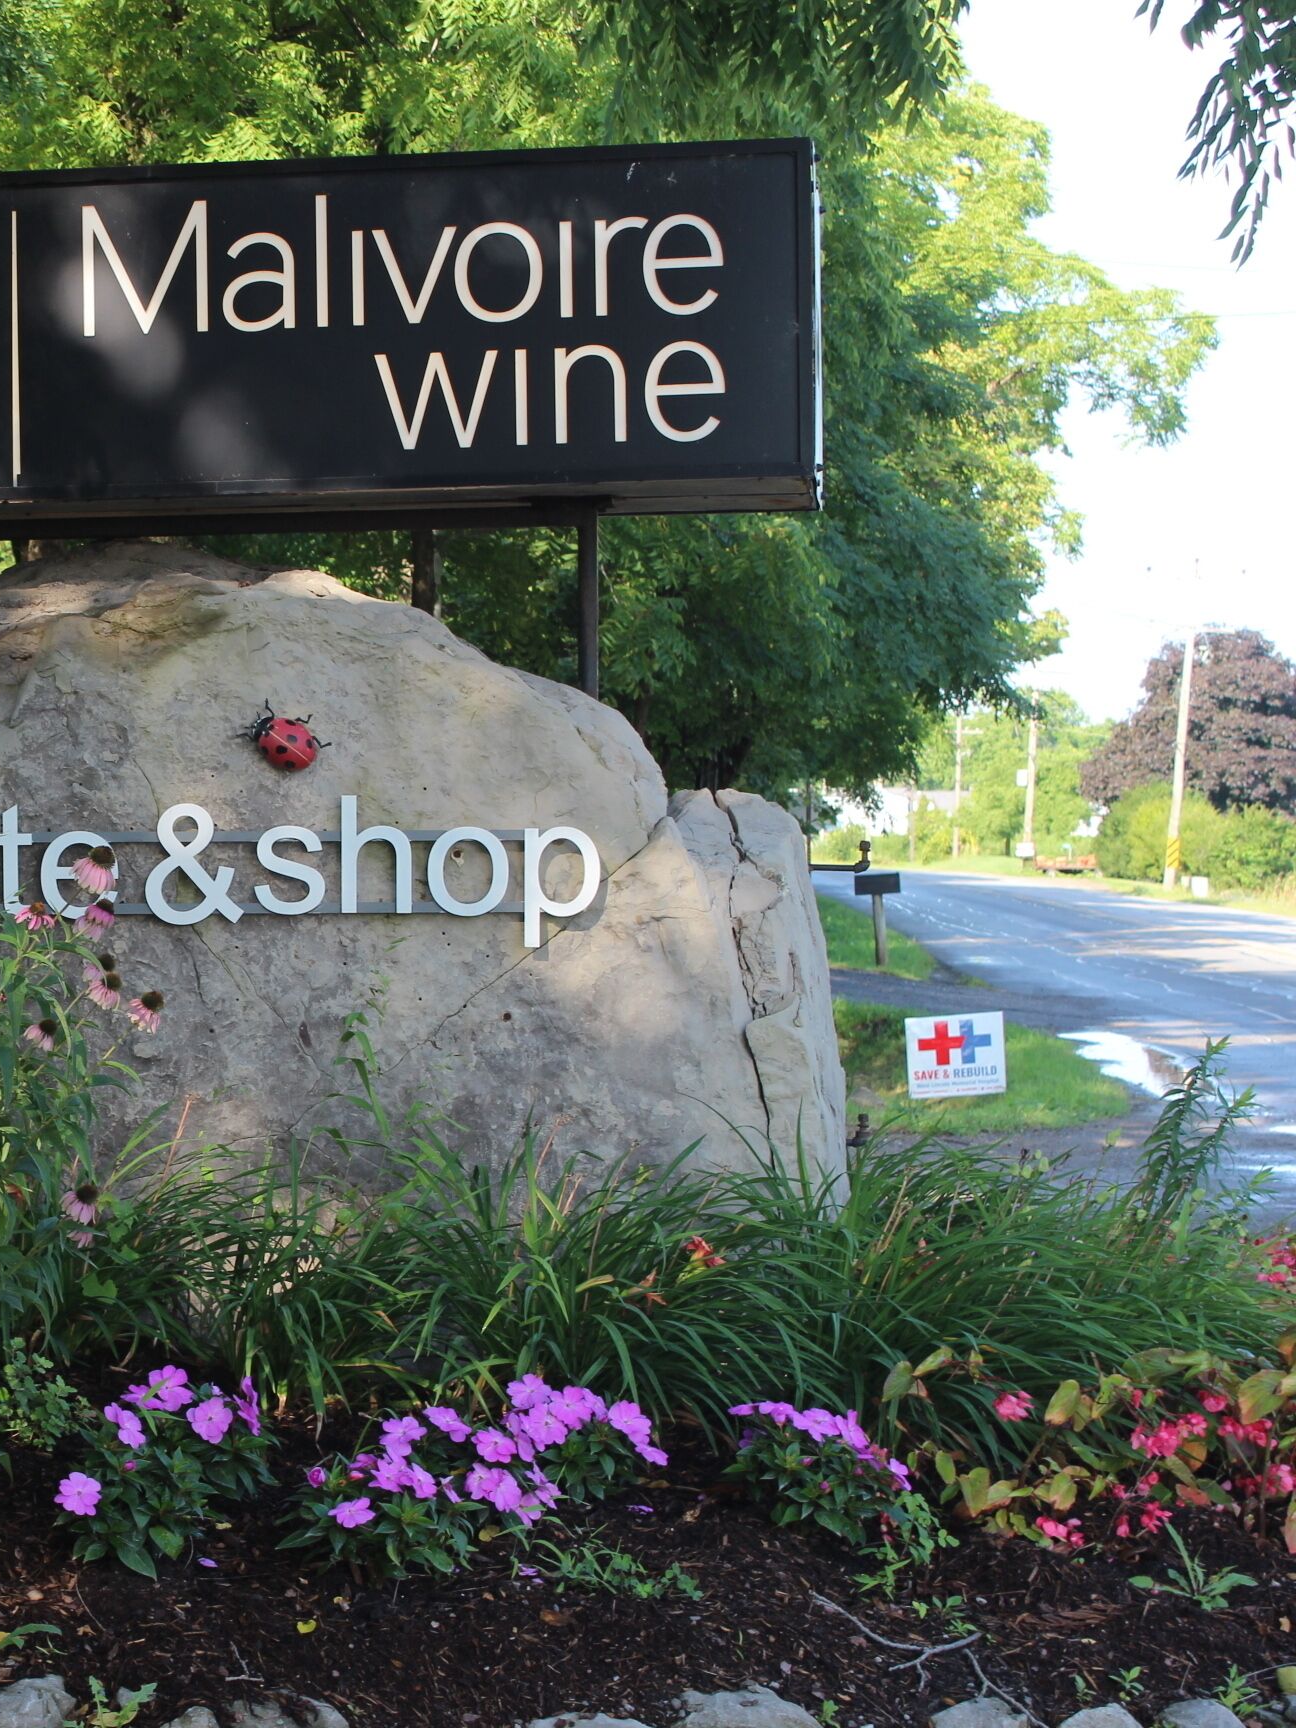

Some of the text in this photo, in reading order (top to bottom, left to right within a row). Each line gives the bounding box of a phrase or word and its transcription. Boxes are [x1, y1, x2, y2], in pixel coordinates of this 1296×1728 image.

[81, 194, 725, 337] Malivoire
[374, 340, 726, 450] wine
[914, 1069, 939, 1081] SAVE
[953, 1065, 997, 1078] REBUILD
